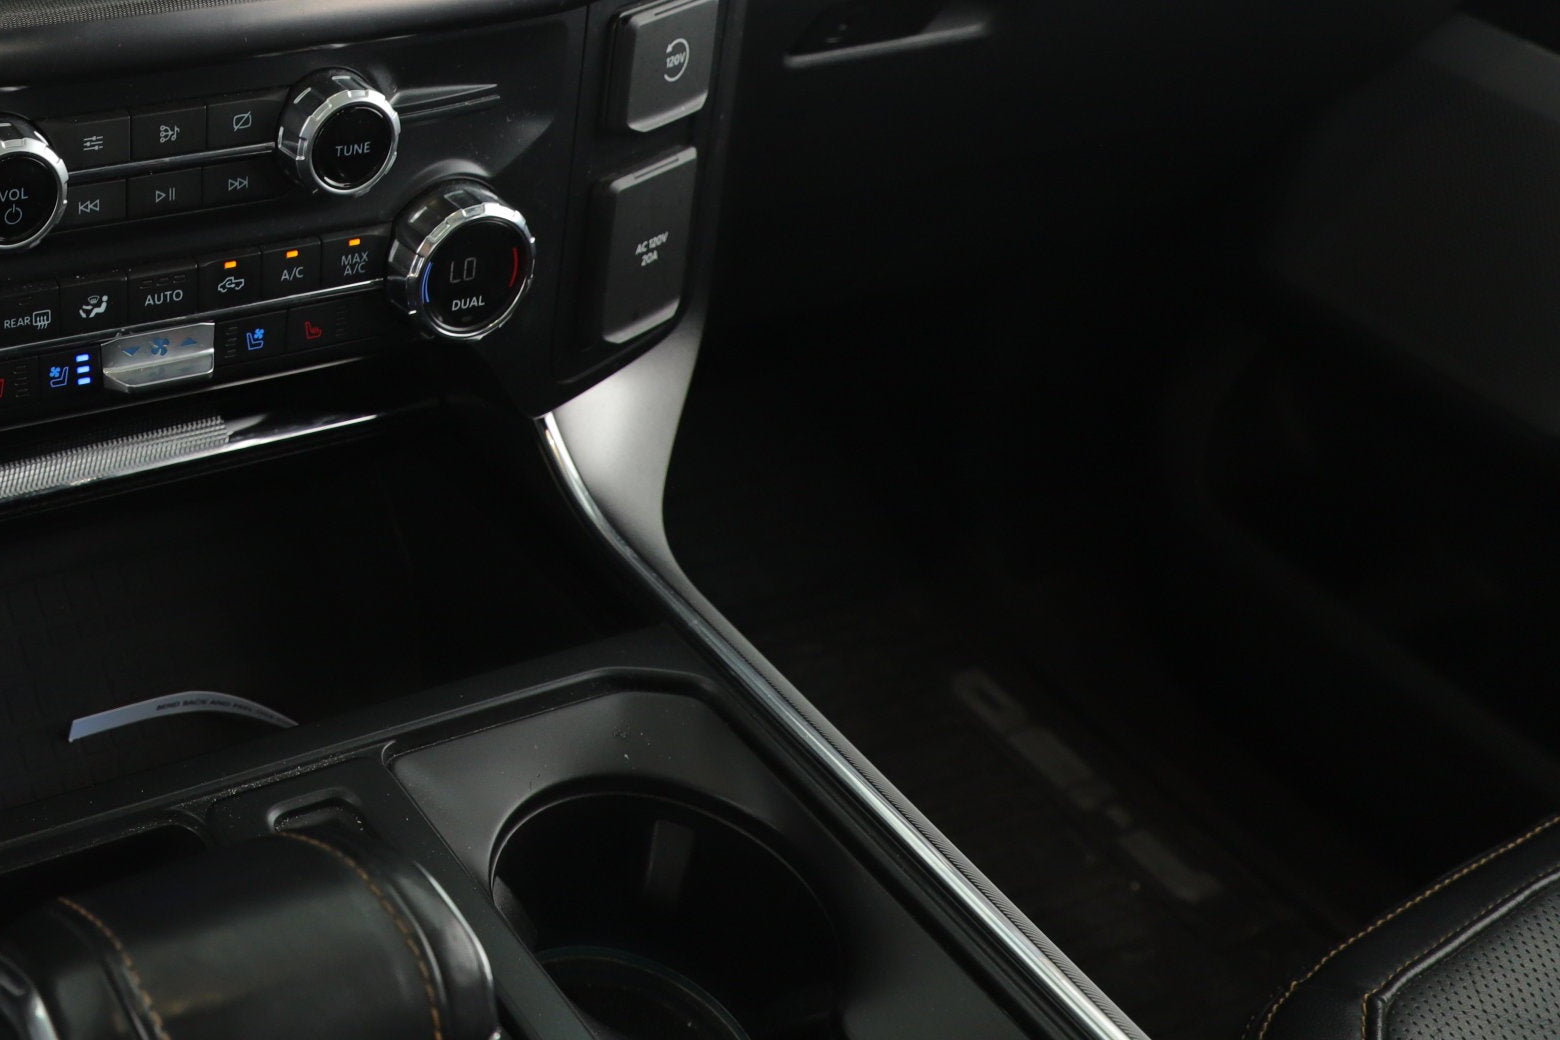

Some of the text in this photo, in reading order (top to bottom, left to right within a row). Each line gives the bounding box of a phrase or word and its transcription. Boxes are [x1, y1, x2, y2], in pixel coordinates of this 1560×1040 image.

[666, 50, 686, 69] 120V
[335, 141, 371, 157] TUNE
[341, 250, 369, 266] MAX
[281, 266, 304, 282] A/C
[343, 261, 366, 277] A/C
[144, 289, 183, 306] AUTO
[451, 294, 485, 311] DUAL
[3, 316, 31, 330] REAR
